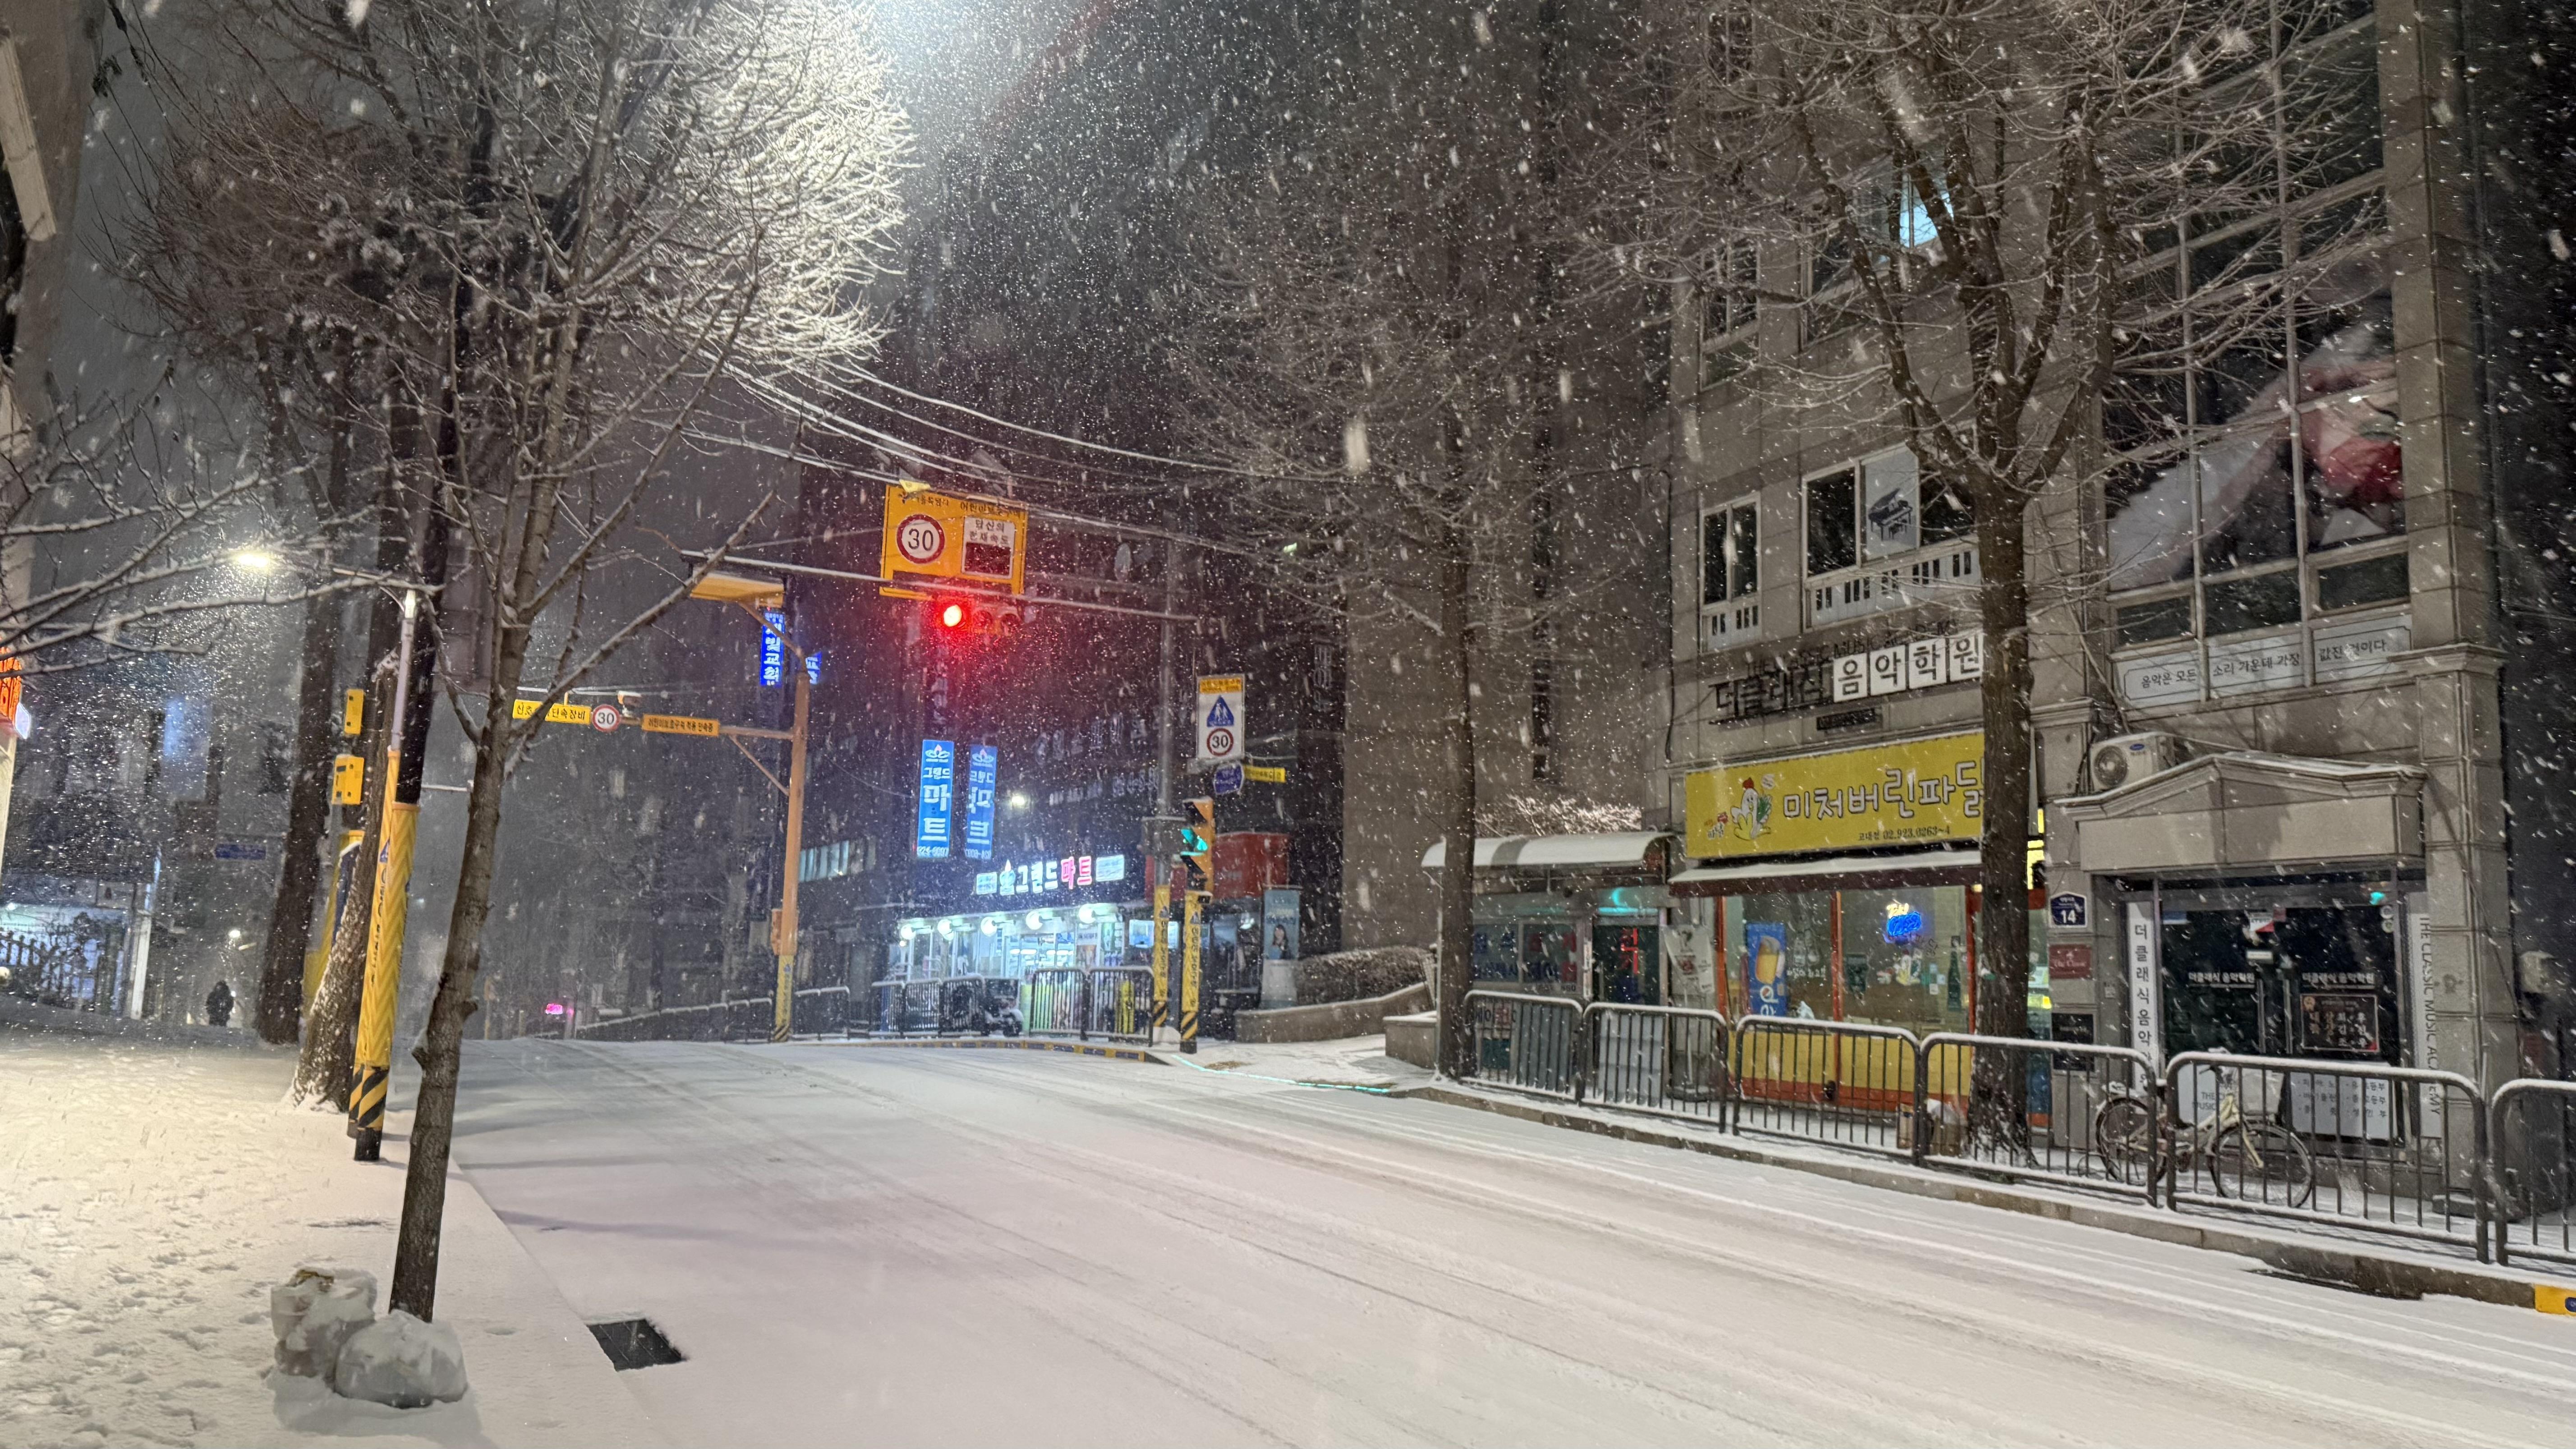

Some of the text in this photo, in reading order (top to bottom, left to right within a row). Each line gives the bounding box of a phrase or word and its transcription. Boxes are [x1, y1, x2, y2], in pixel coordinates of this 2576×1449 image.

[908, 528, 934, 551] 30
[1838, 634, 1980, 695] 음악학원
[598, 712, 615, 725] 30
[1212, 735, 1229, 749] 30
[920, 784, 951, 842] 마트
[2061, 910, 2076, 924] 14
[2420, 917, 2431, 938] THE
[2425, 1000, 2436, 1042] MUSIC
[2427, 1044, 2440, 1115] ACEMY
